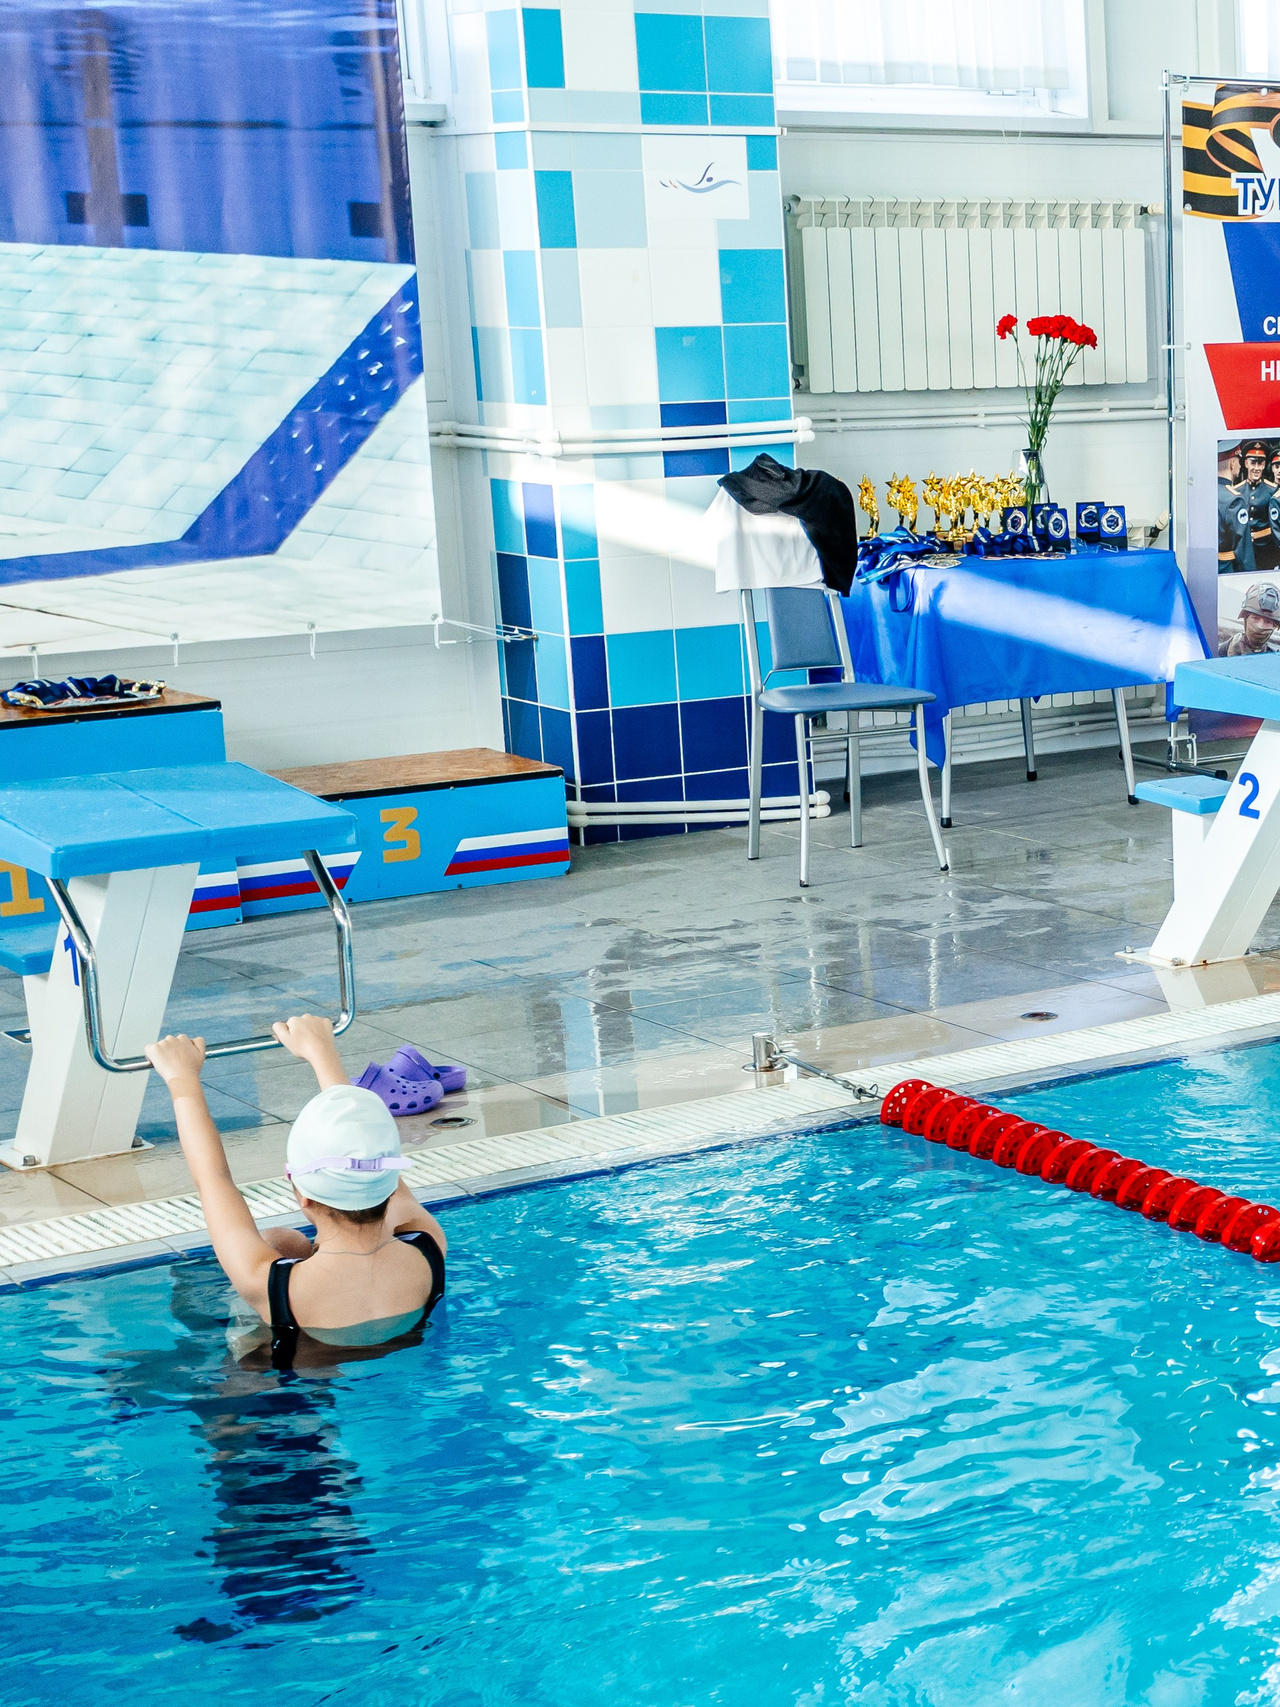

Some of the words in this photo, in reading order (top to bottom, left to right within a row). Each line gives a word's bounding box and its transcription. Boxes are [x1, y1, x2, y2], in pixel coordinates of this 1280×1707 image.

[1238, 771, 1260, 820] 2
[380, 806, 421, 864] 3
[0, 858, 45, 917] 1
[63, 931, 80, 987] 1
